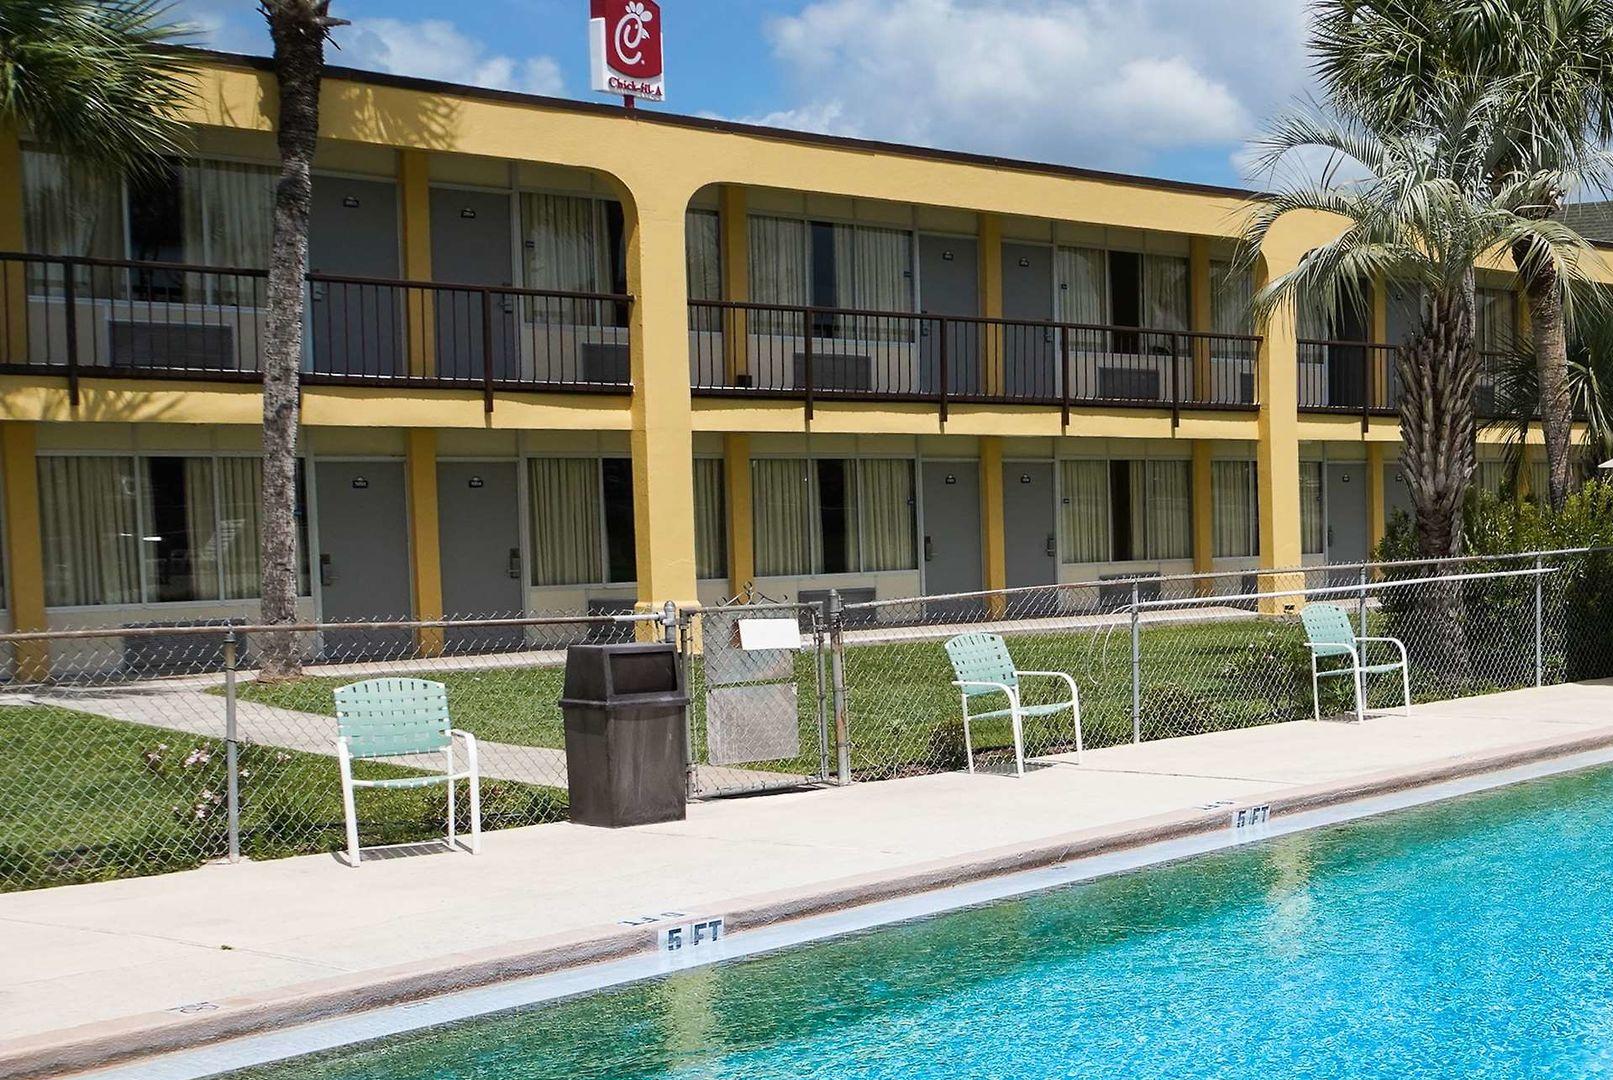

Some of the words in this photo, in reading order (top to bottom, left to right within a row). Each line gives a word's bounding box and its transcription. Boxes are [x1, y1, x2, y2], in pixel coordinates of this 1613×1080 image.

[609, 77, 662, 96] Chick-fil-A
[1237, 810, 1246, 828] 5
[1252, 806, 1269, 825] FT
[668, 928, 682, 951] 5
[693, 920, 722, 946] FT
